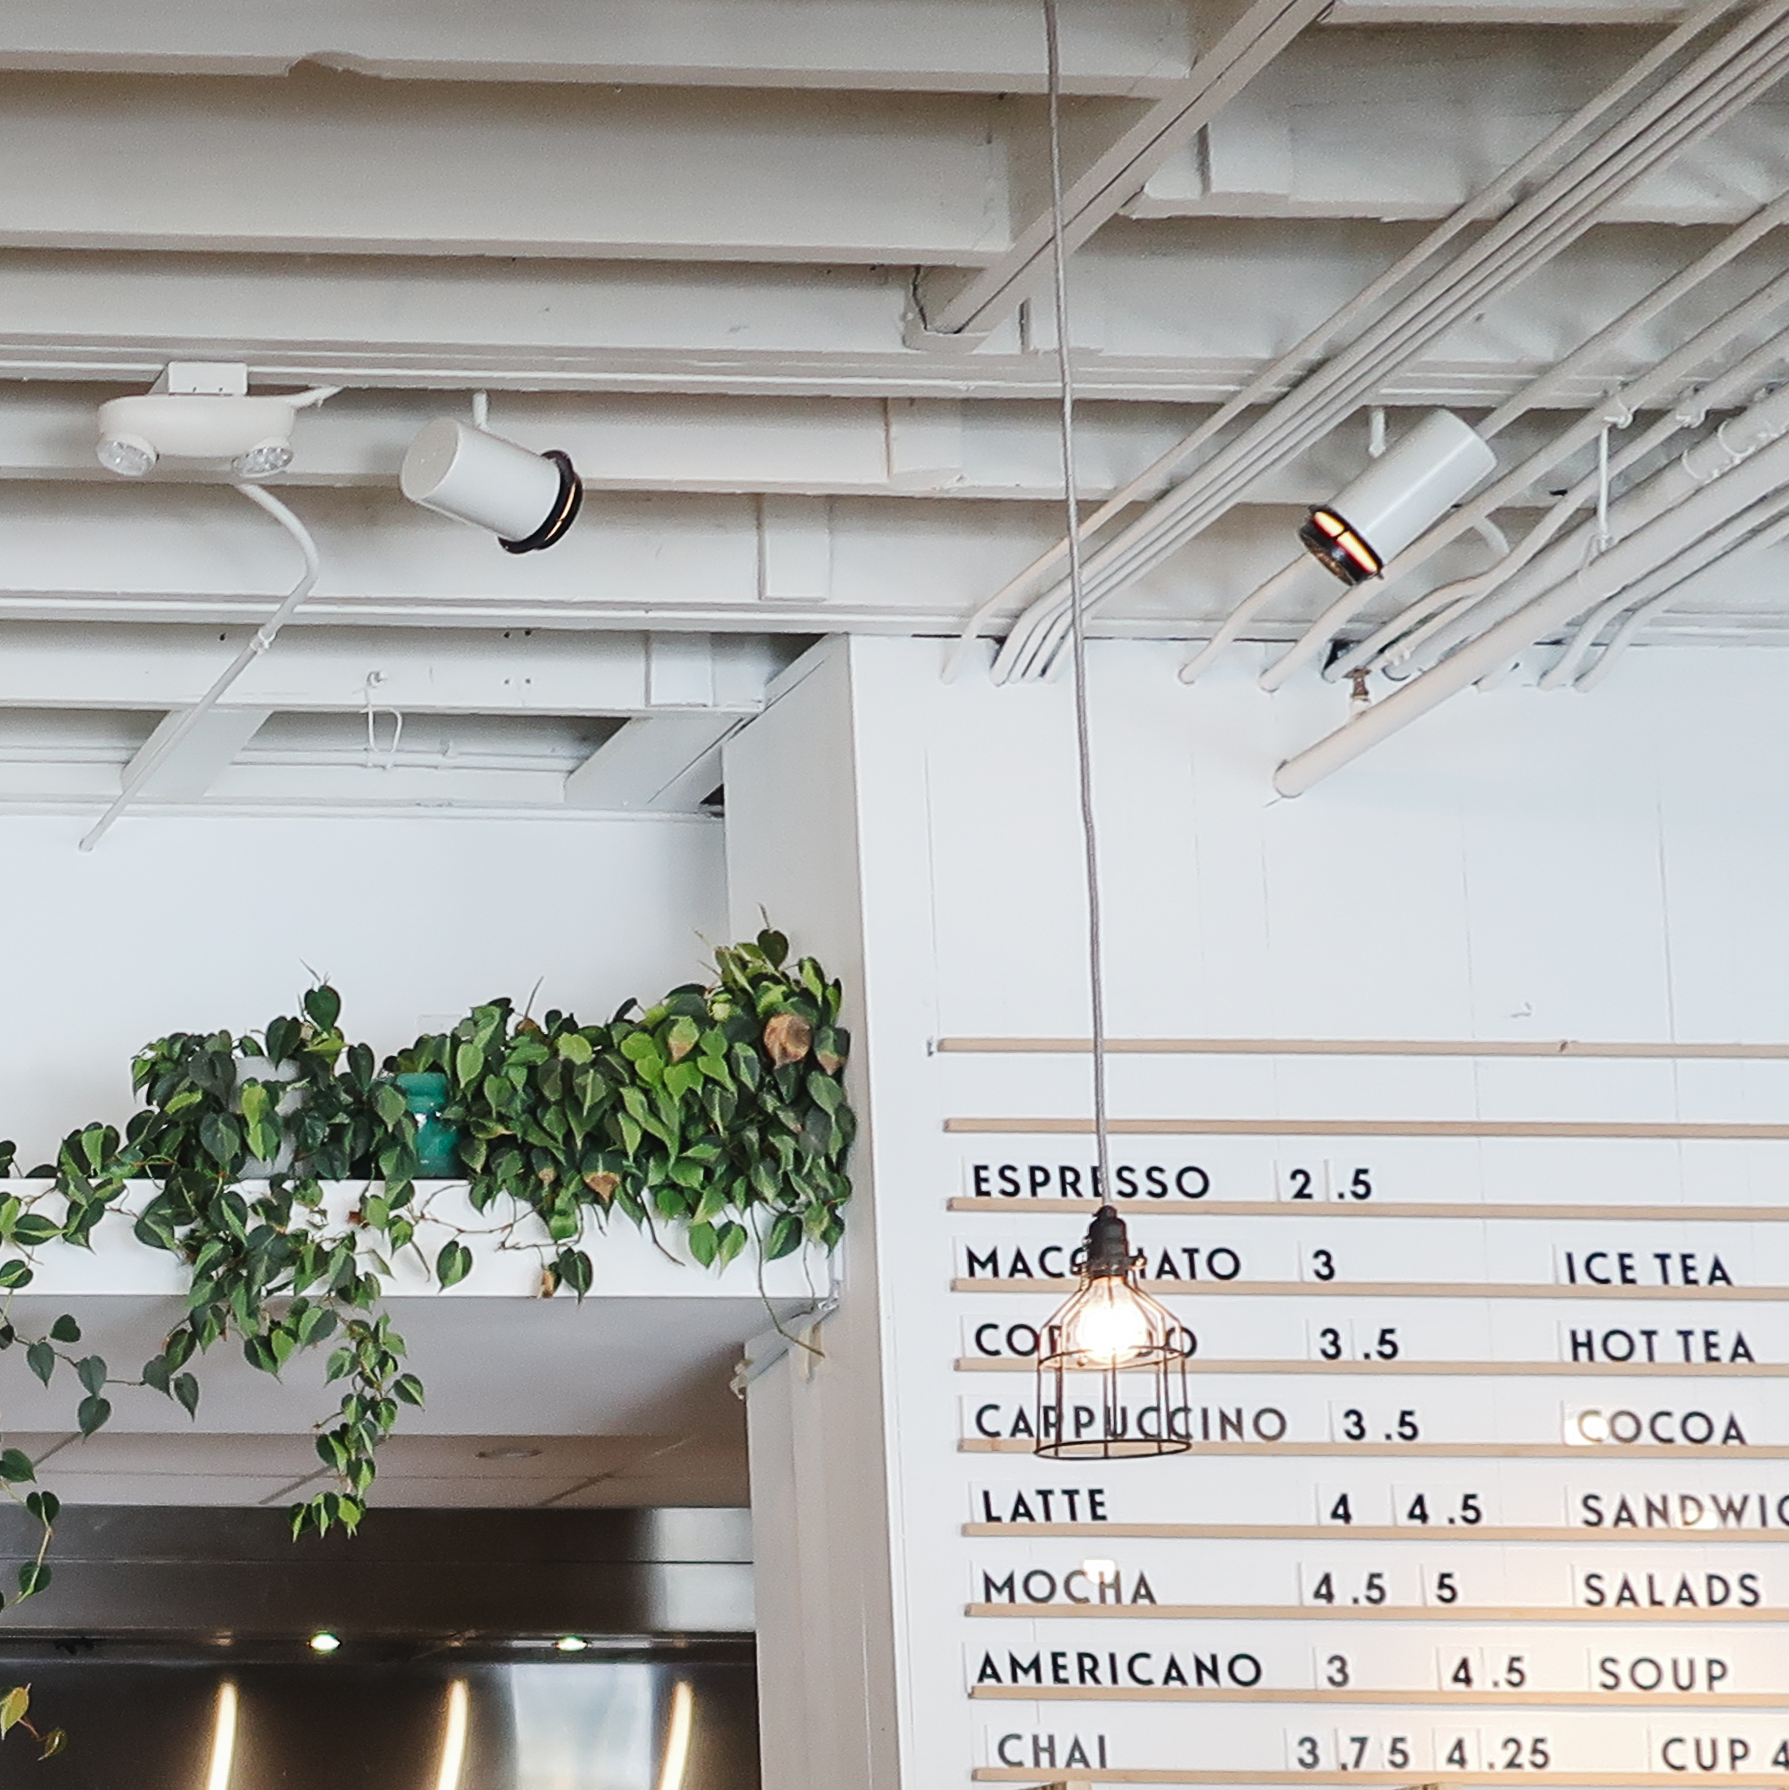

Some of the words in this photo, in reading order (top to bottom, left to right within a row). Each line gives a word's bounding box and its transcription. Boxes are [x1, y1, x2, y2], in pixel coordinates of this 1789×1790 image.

[1313, 1250, 1336, 1282] 3
[1566, 1252, 1639, 1286] ICE
[1654, 1253, 1734, 1287] TEA
[1571, 1329, 1659, 1363] HOT
[1677, 1330, 1756, 1364] TEA
[975, 1402, 1288, 1442] CAPPUCCINO
[1577, 1410, 1748, 1446] COCOA
[983, 1489, 1109, 1524] LATTE
[1331, 1494, 1353, 1525] 4
[984, 1569, 1158, 1604] MOCHA
[1437, 1573, 1459, 1605] 5
[1585, 1573, 1761, 1609] SALADS
[978, 1652, 1263, 1688] AMERICANO
[1328, 1655, 1350, 1688] 3
[1600, 1657, 1728, 1692] SOUP
[998, 1734, 1108, 1770] CHAI
[1662, 1738, 1749, 1773] CUP
